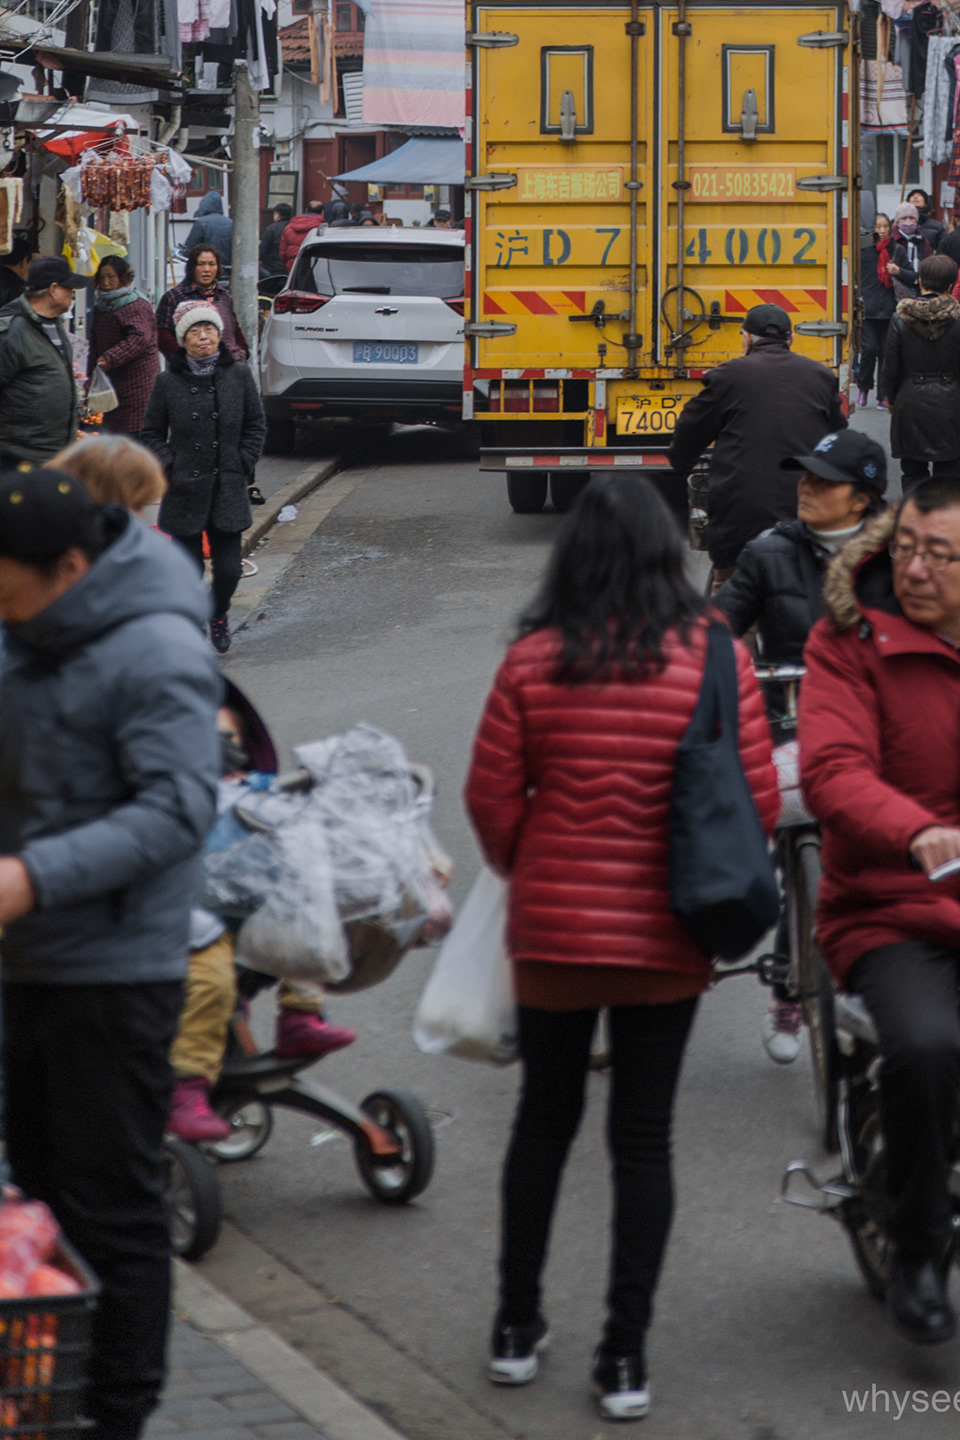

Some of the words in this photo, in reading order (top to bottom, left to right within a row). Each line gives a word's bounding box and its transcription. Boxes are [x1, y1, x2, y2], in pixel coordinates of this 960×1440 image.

[521, 172, 620, 199] 上海东吉搬场公司
[693, 172, 795, 197] 021-50835421
[621, 410, 678, 432] 7400
